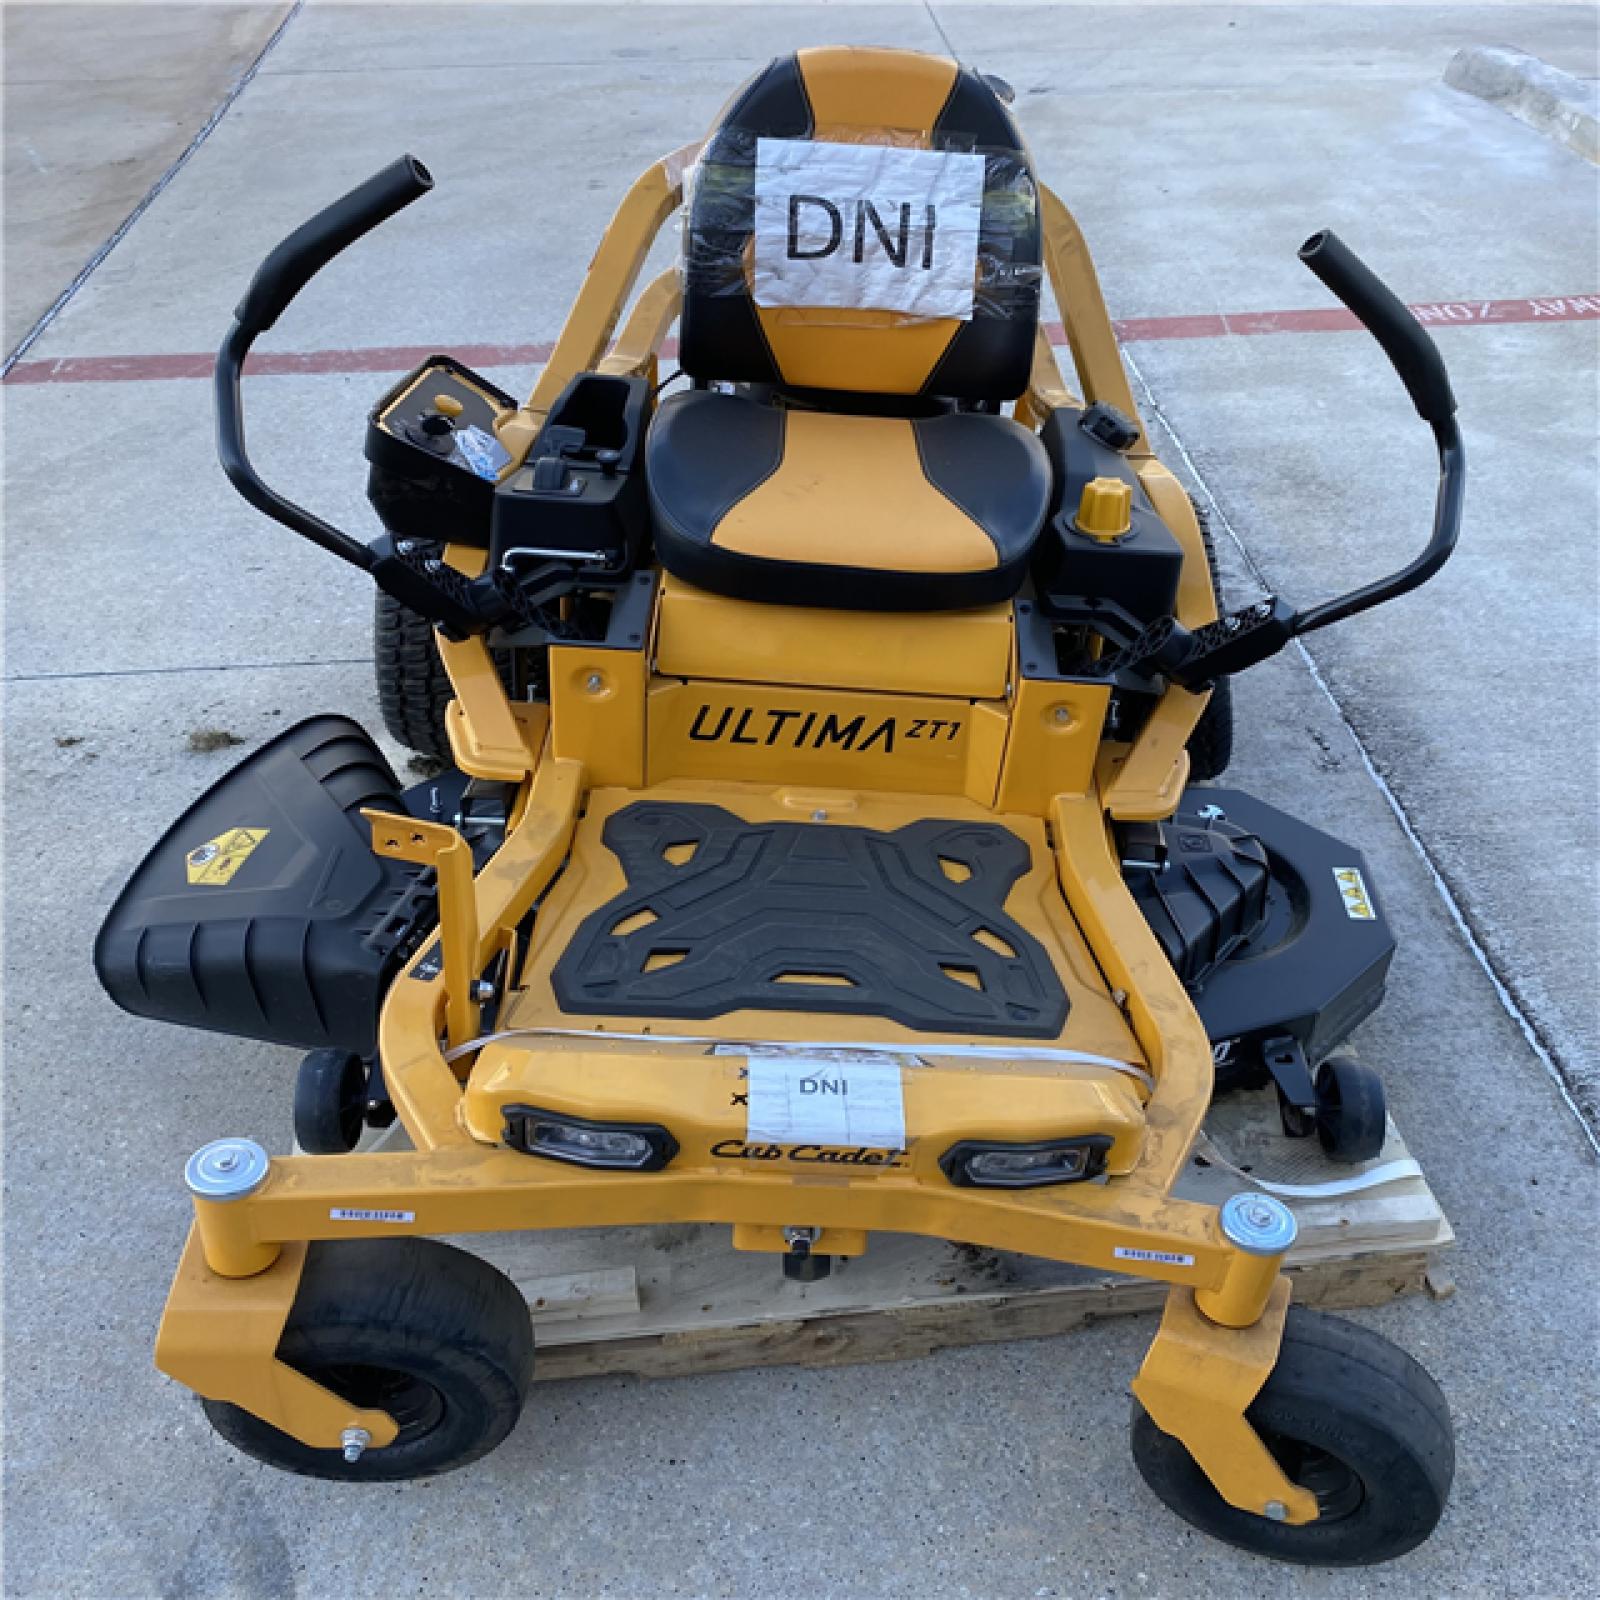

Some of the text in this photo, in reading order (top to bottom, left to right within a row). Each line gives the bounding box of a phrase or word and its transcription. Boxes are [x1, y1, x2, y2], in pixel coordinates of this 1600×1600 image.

[787, 195, 936, 270] DNI
[689, 704, 962, 753] ULTIMA ZT1
[799, 1078, 849, 1096] DNI
[709, 1139, 911, 1168] Cub Cadet
